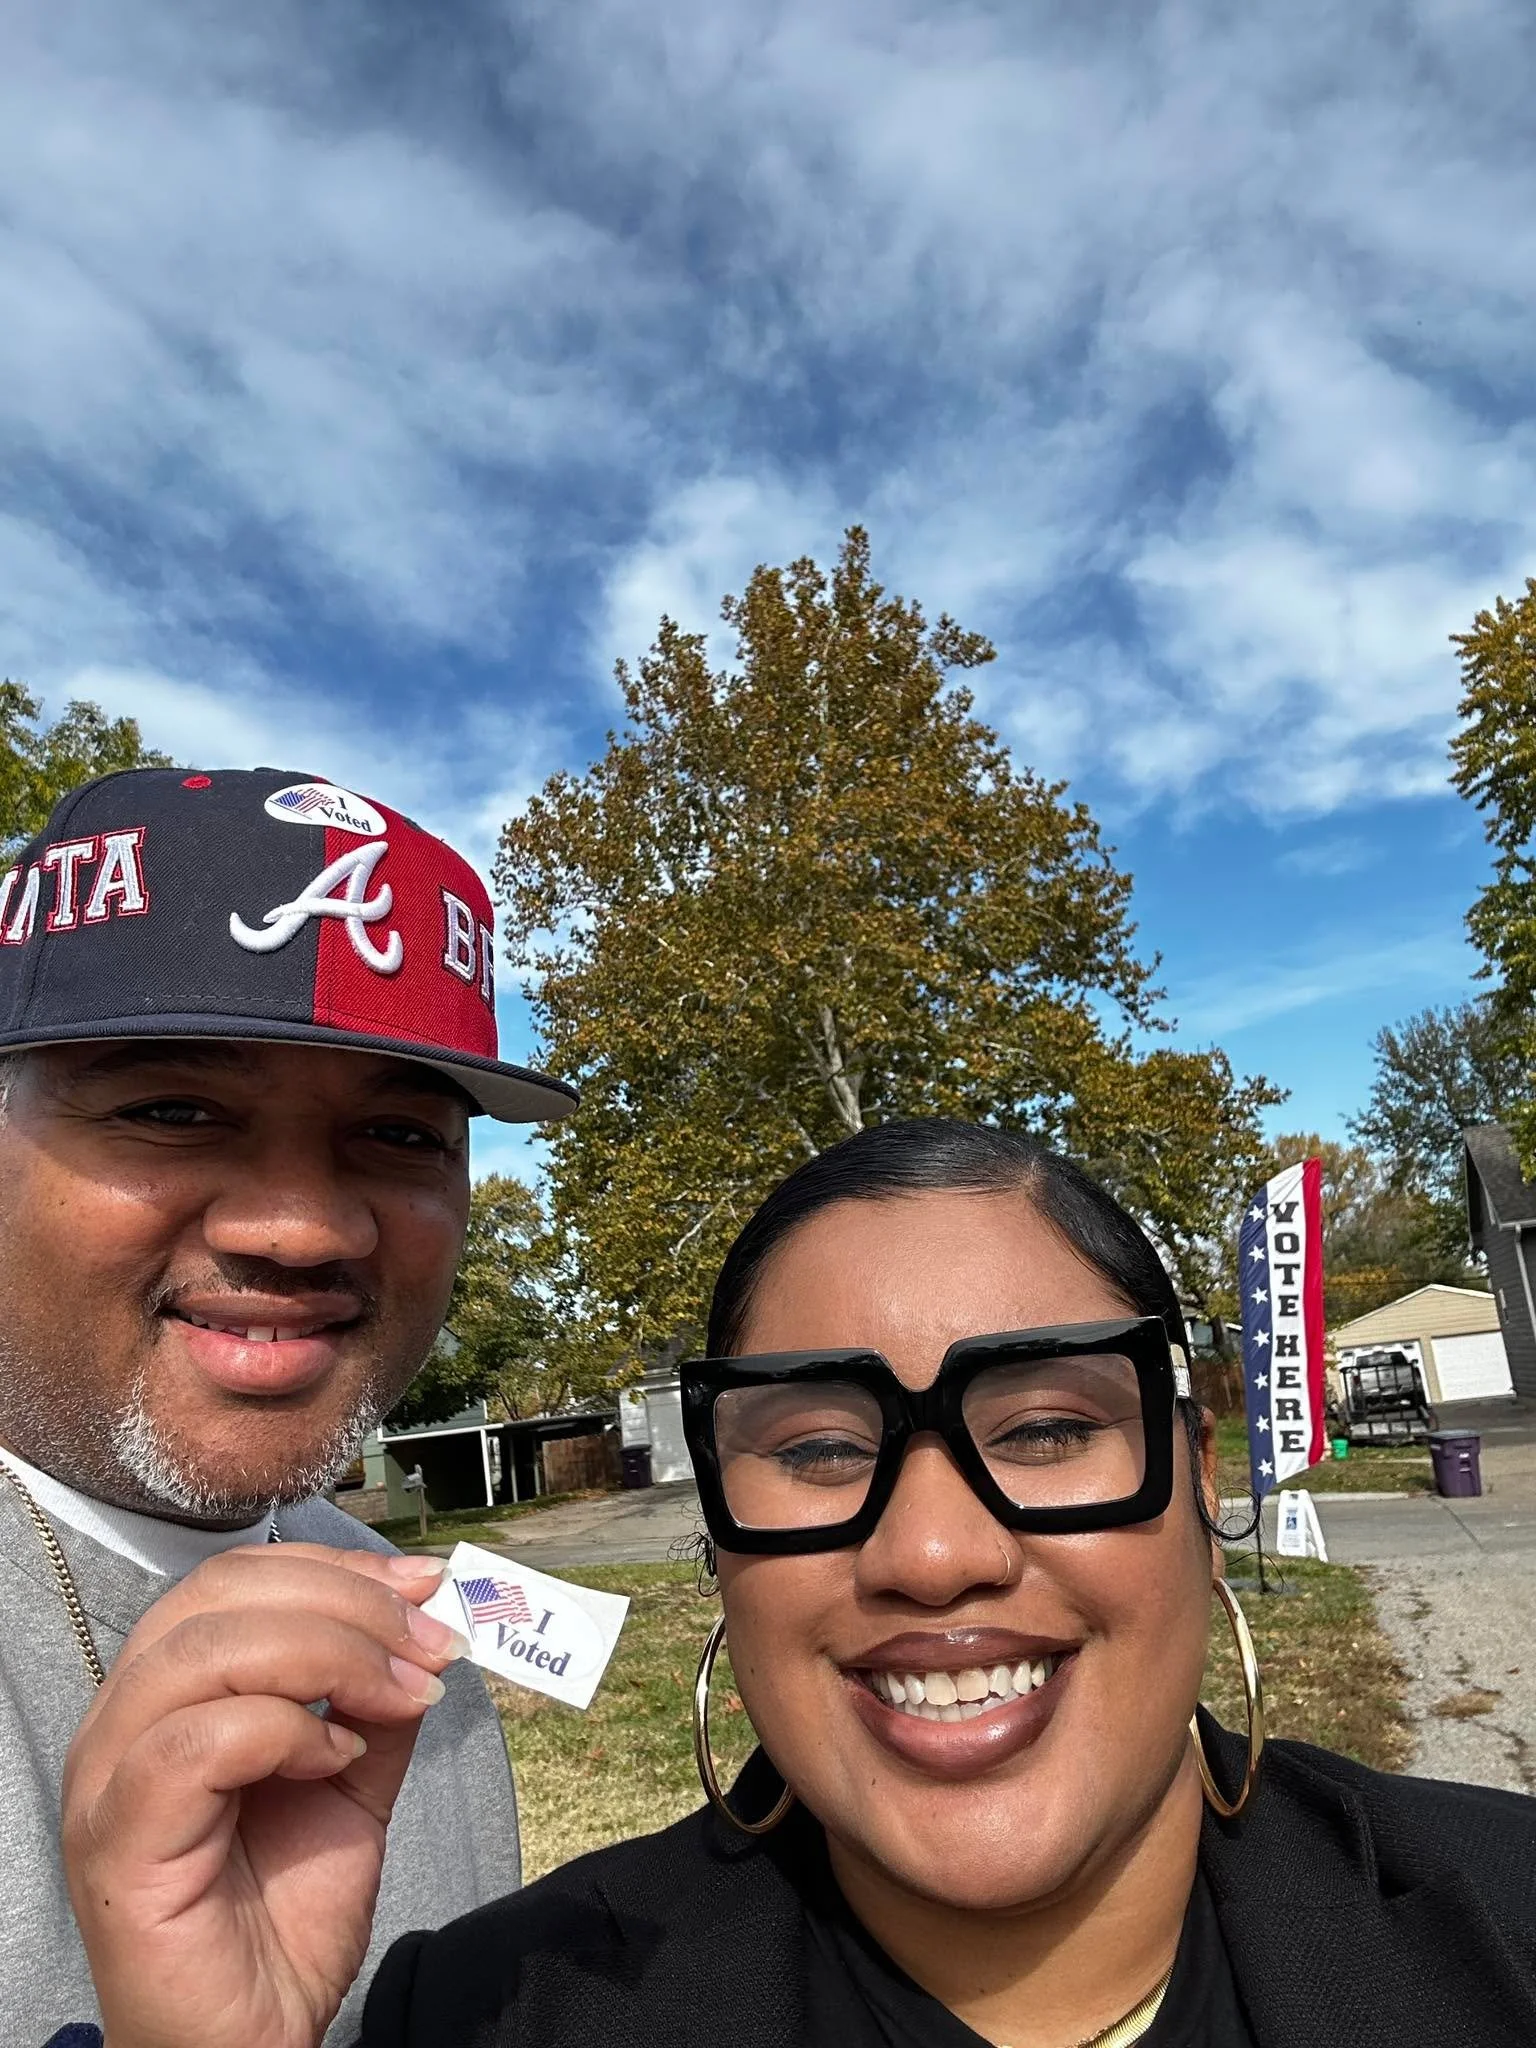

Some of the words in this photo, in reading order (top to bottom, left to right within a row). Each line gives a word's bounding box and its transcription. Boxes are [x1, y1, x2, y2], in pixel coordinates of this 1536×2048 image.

[318, 806, 373, 833] Voted
[337, 795, 348, 811] I
[229, 840, 404, 975] A
[1270, 1200, 1300, 1317] VOTE
[1275, 1334, 1306, 1453] HERE
[494, 1621, 573, 1678] Voted
[533, 1608, 556, 1636] I
